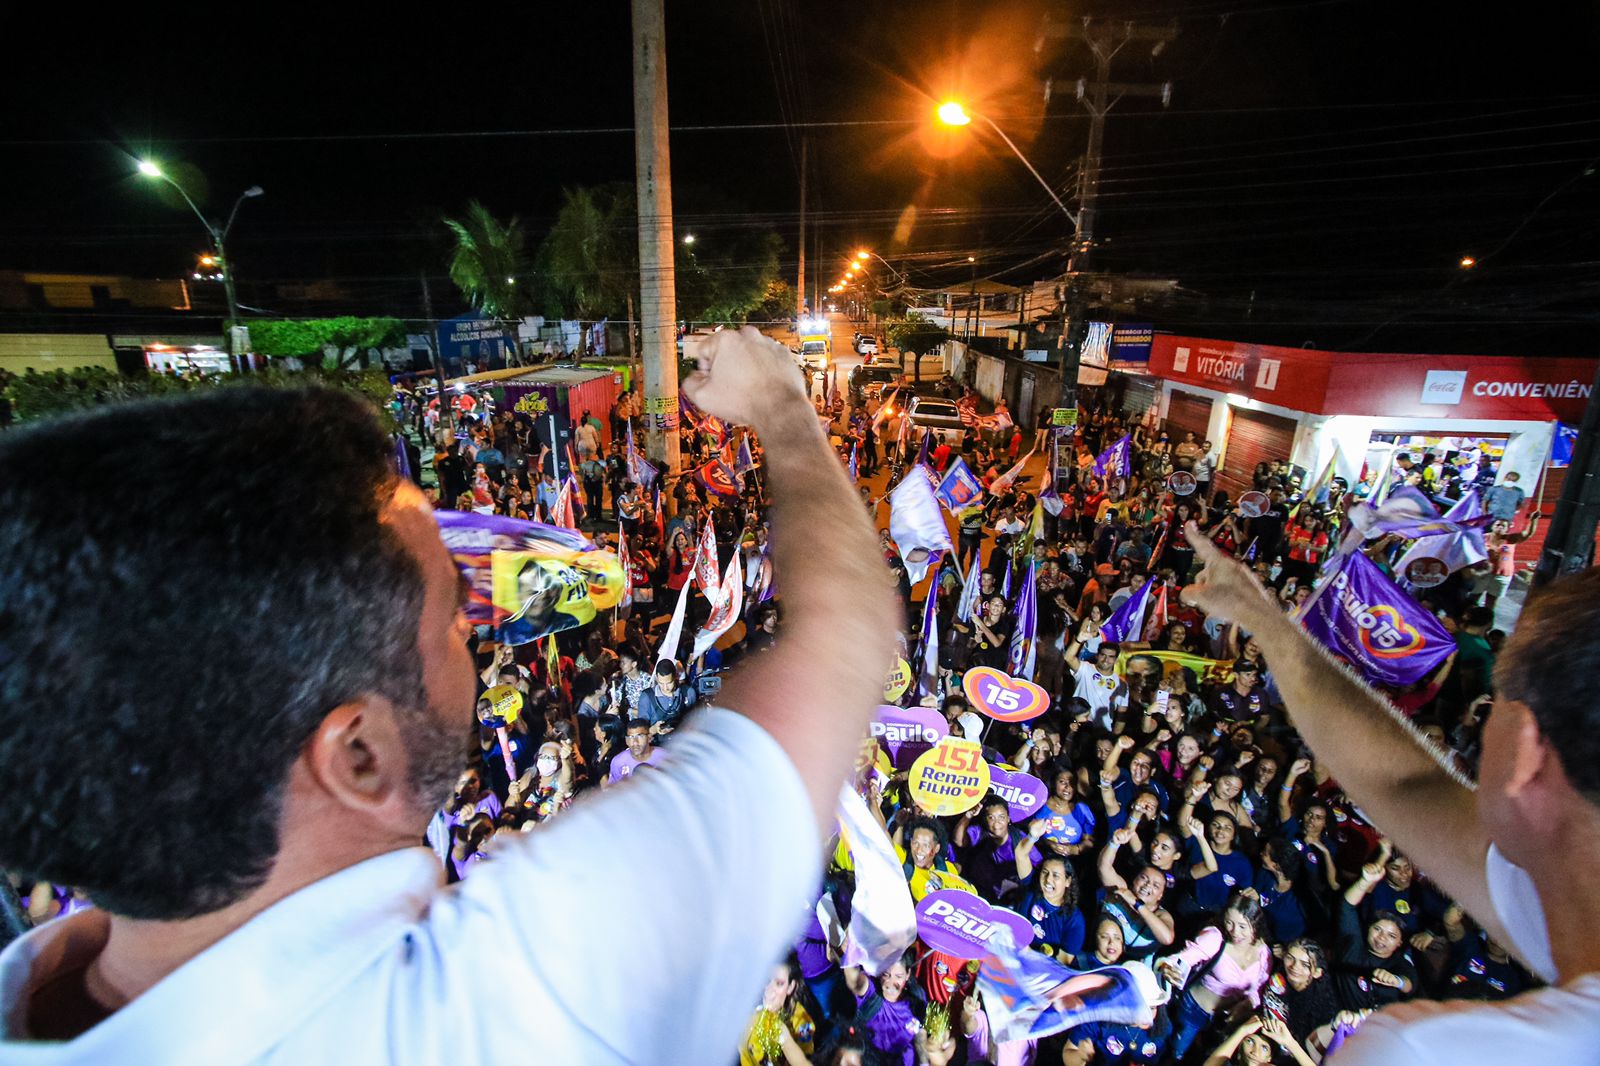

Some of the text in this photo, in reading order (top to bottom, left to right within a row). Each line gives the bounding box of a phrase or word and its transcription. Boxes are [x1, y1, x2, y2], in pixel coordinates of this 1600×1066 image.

[1197, 353, 1245, 381] VITÓRIA
[1331, 570, 1377, 629] Paulo
[1371, 620, 1403, 647] 15
[986, 683, 1021, 710] 15
[870, 722, 939, 743] Paulo
[934, 745, 981, 773] 151
[918, 780, 962, 797] FILHO
[921, 766, 980, 787] Renan
